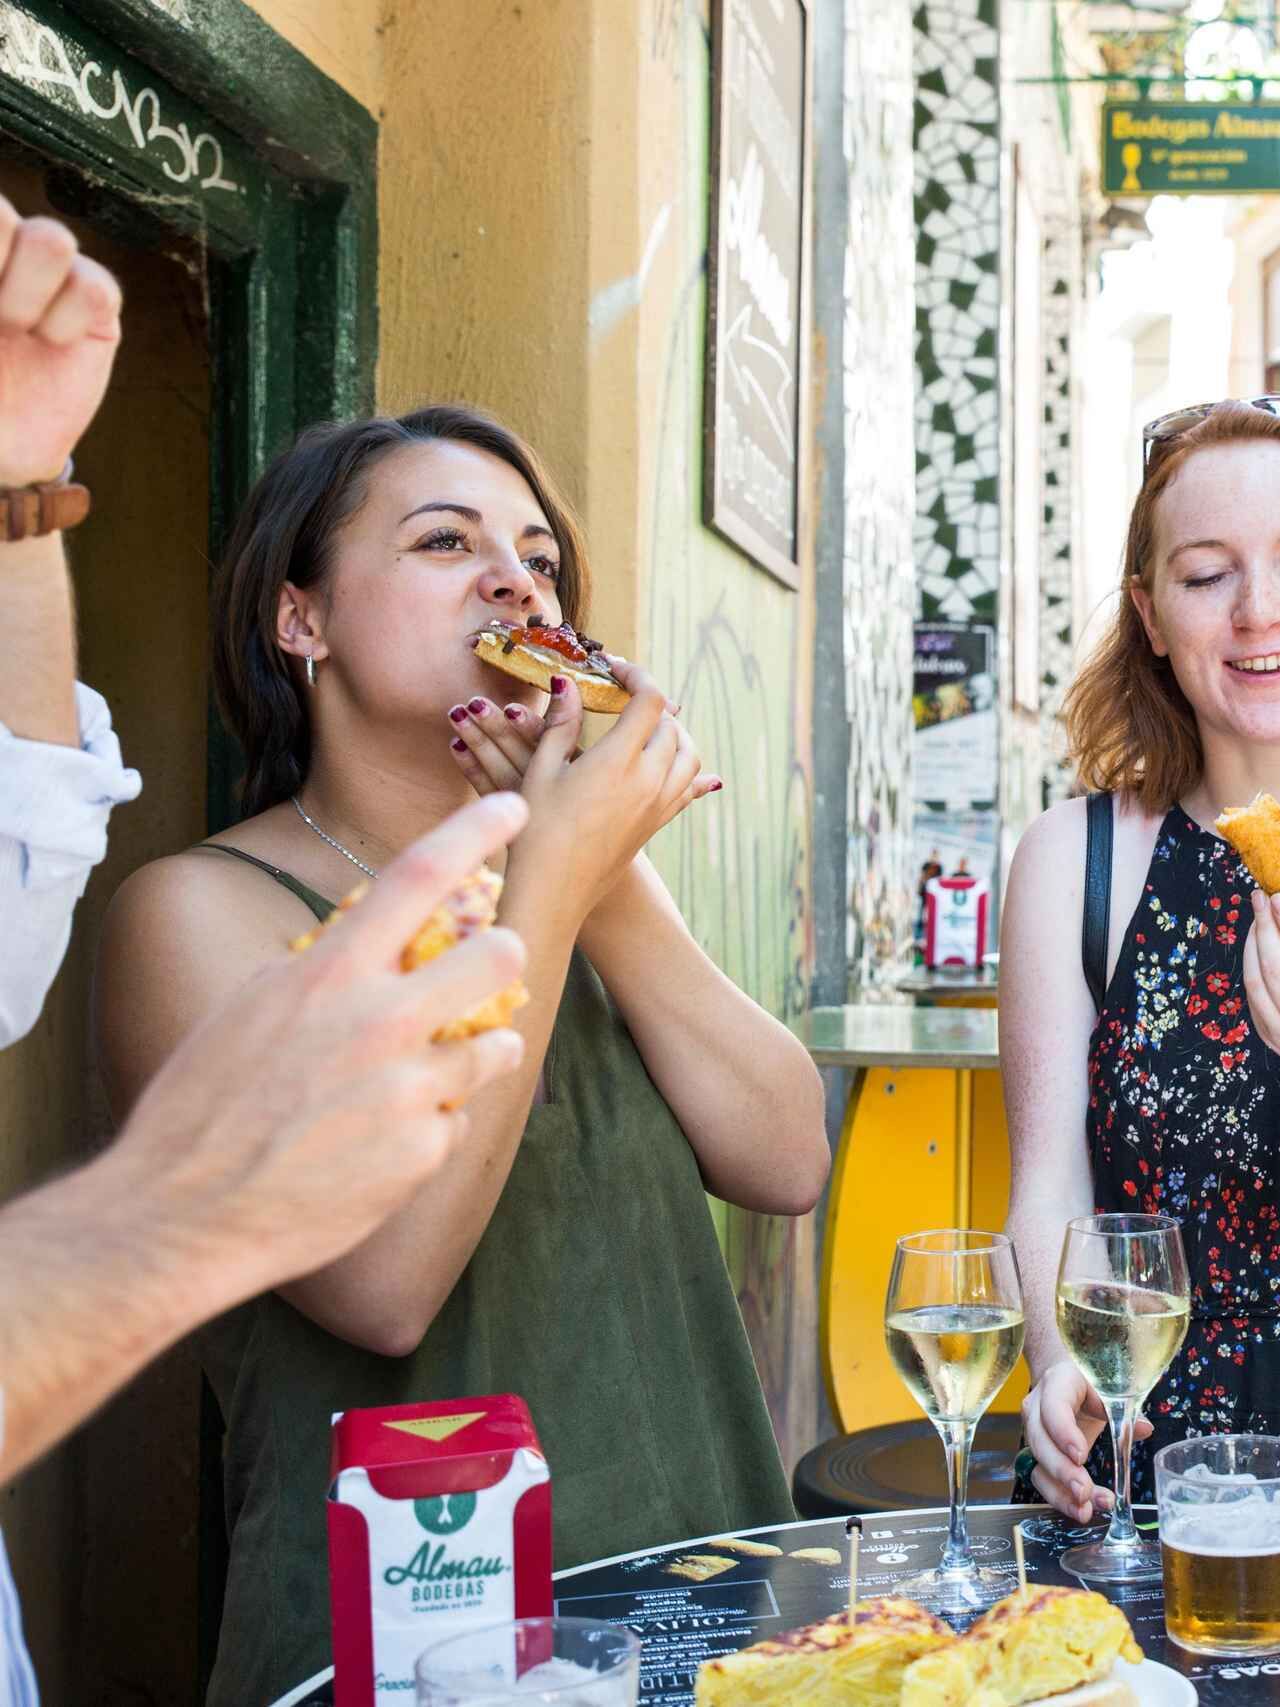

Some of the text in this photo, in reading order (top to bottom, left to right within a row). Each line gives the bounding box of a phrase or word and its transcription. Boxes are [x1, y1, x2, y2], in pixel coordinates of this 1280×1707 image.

[1112, 111, 1211, 144] Bodegas
[384, 1540, 503, 1586] Almau
[412, 1580, 485, 1602] BODEGAS
